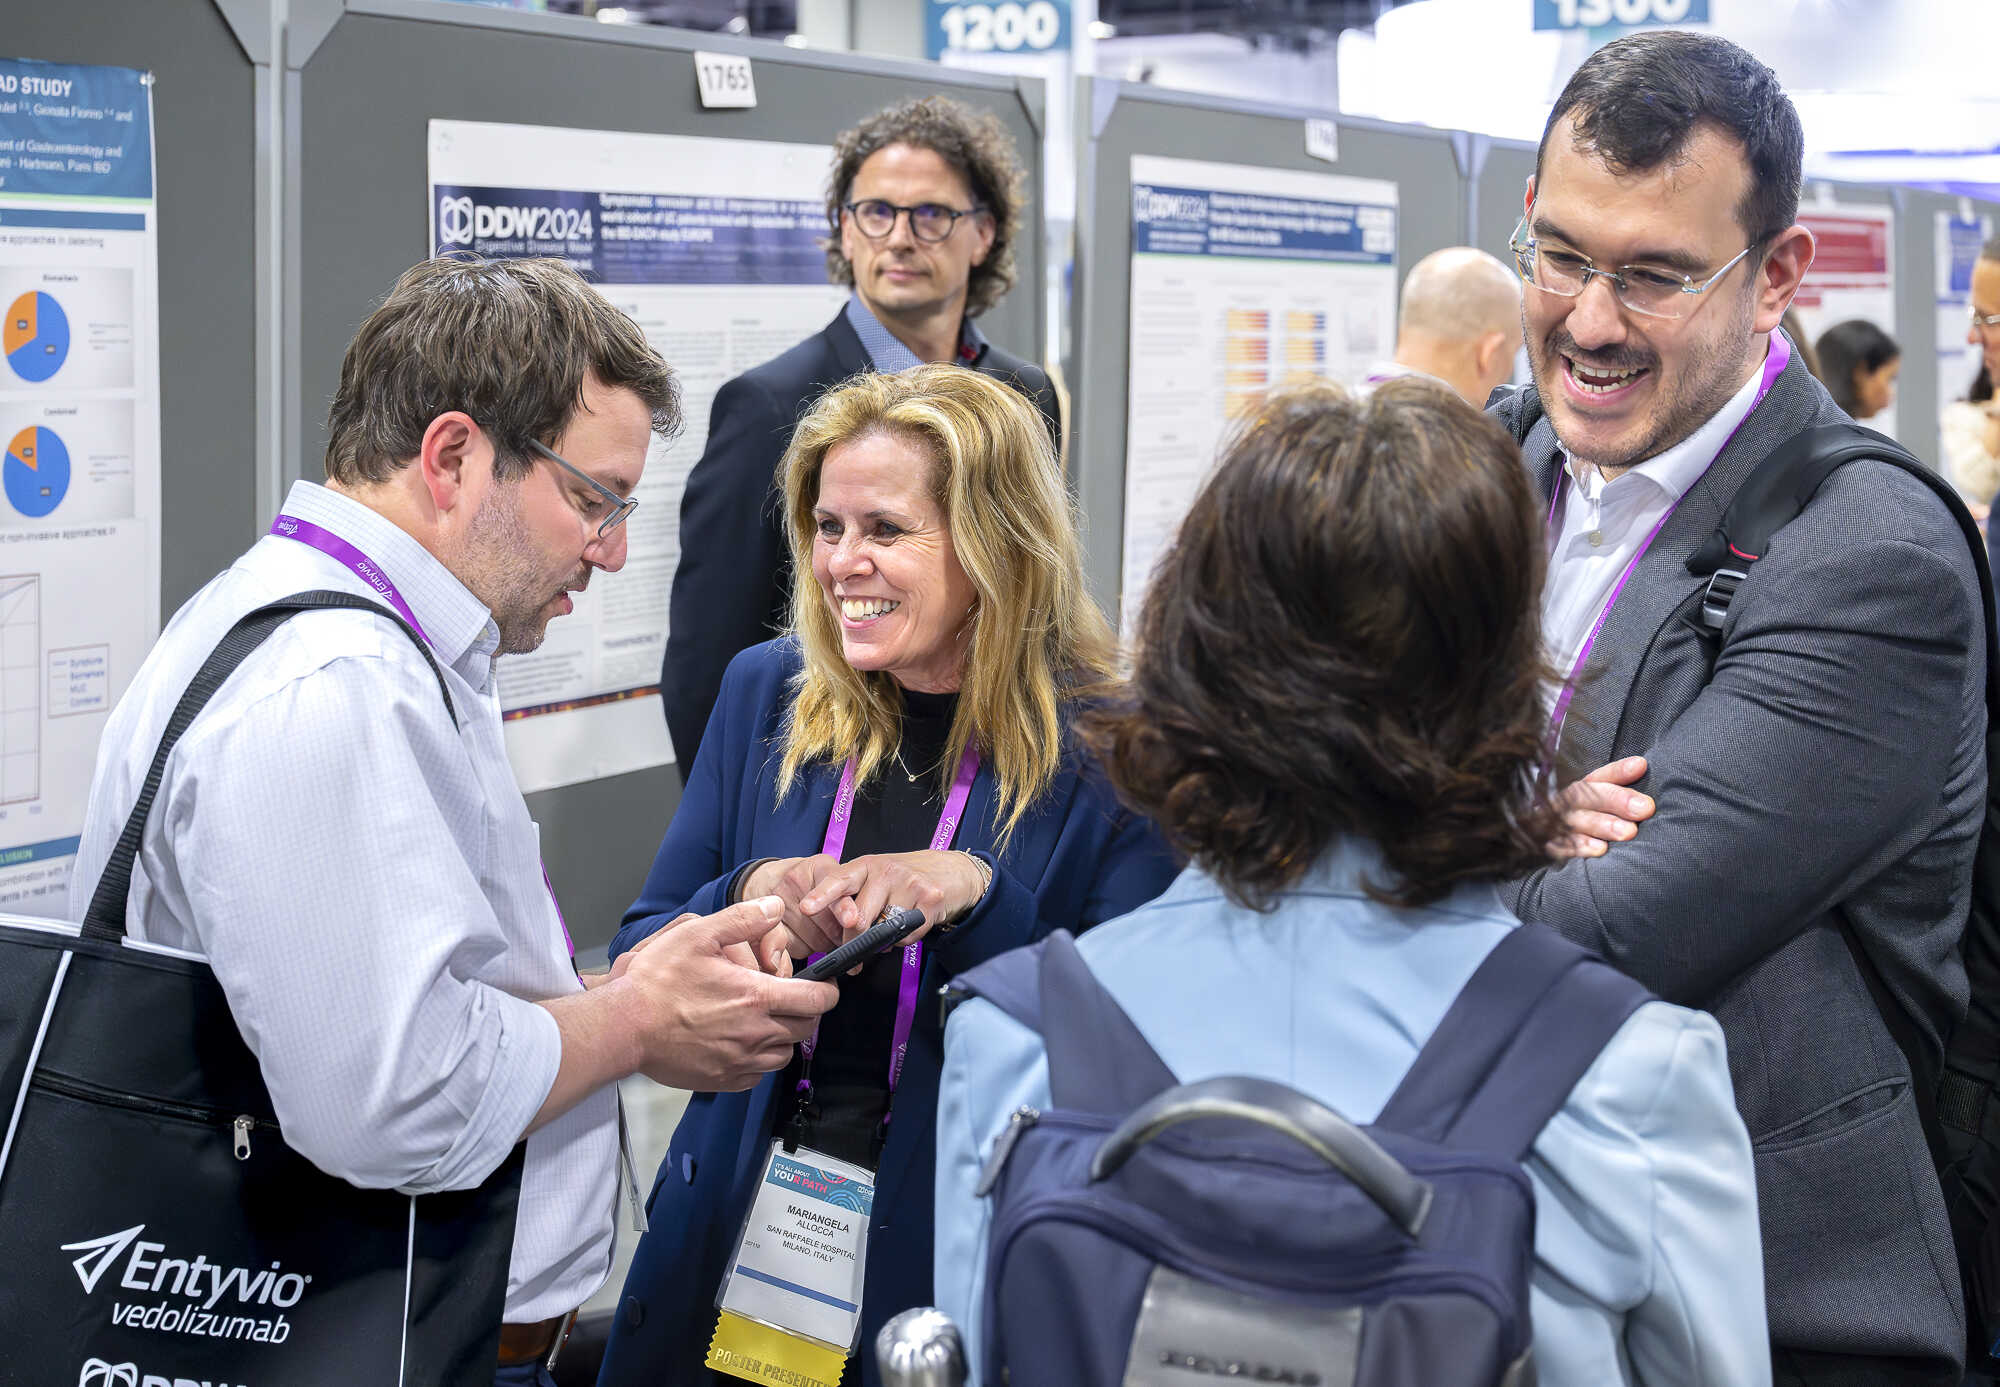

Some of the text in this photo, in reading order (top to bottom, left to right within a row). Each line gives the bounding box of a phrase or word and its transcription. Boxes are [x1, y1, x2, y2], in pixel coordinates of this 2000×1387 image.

[940, 2, 1059, 50] 1200
[21, 77, 72, 97] STUDY
[703, 65, 749, 91] 1765
[475, 205, 592, 240] DDW2024
[356, 562, 388, 592] Entyvio
[838, 783, 850, 815] Entyvio
[909, 942, 918, 968] tyvio
[774, 1168, 828, 1194] YOUR PATH
[787, 1204, 849, 1233] MARIANGELA
[796, 1220, 834, 1239] ALLOCCA
[766, 1225, 856, 1261] SAN RAFFAELE HOSPITAL
[782, 1240, 835, 1263] MILANO, ITALY
[111, 1301, 290, 1344] vedolizumab
[714, 1347, 762, 1374] POSTER
